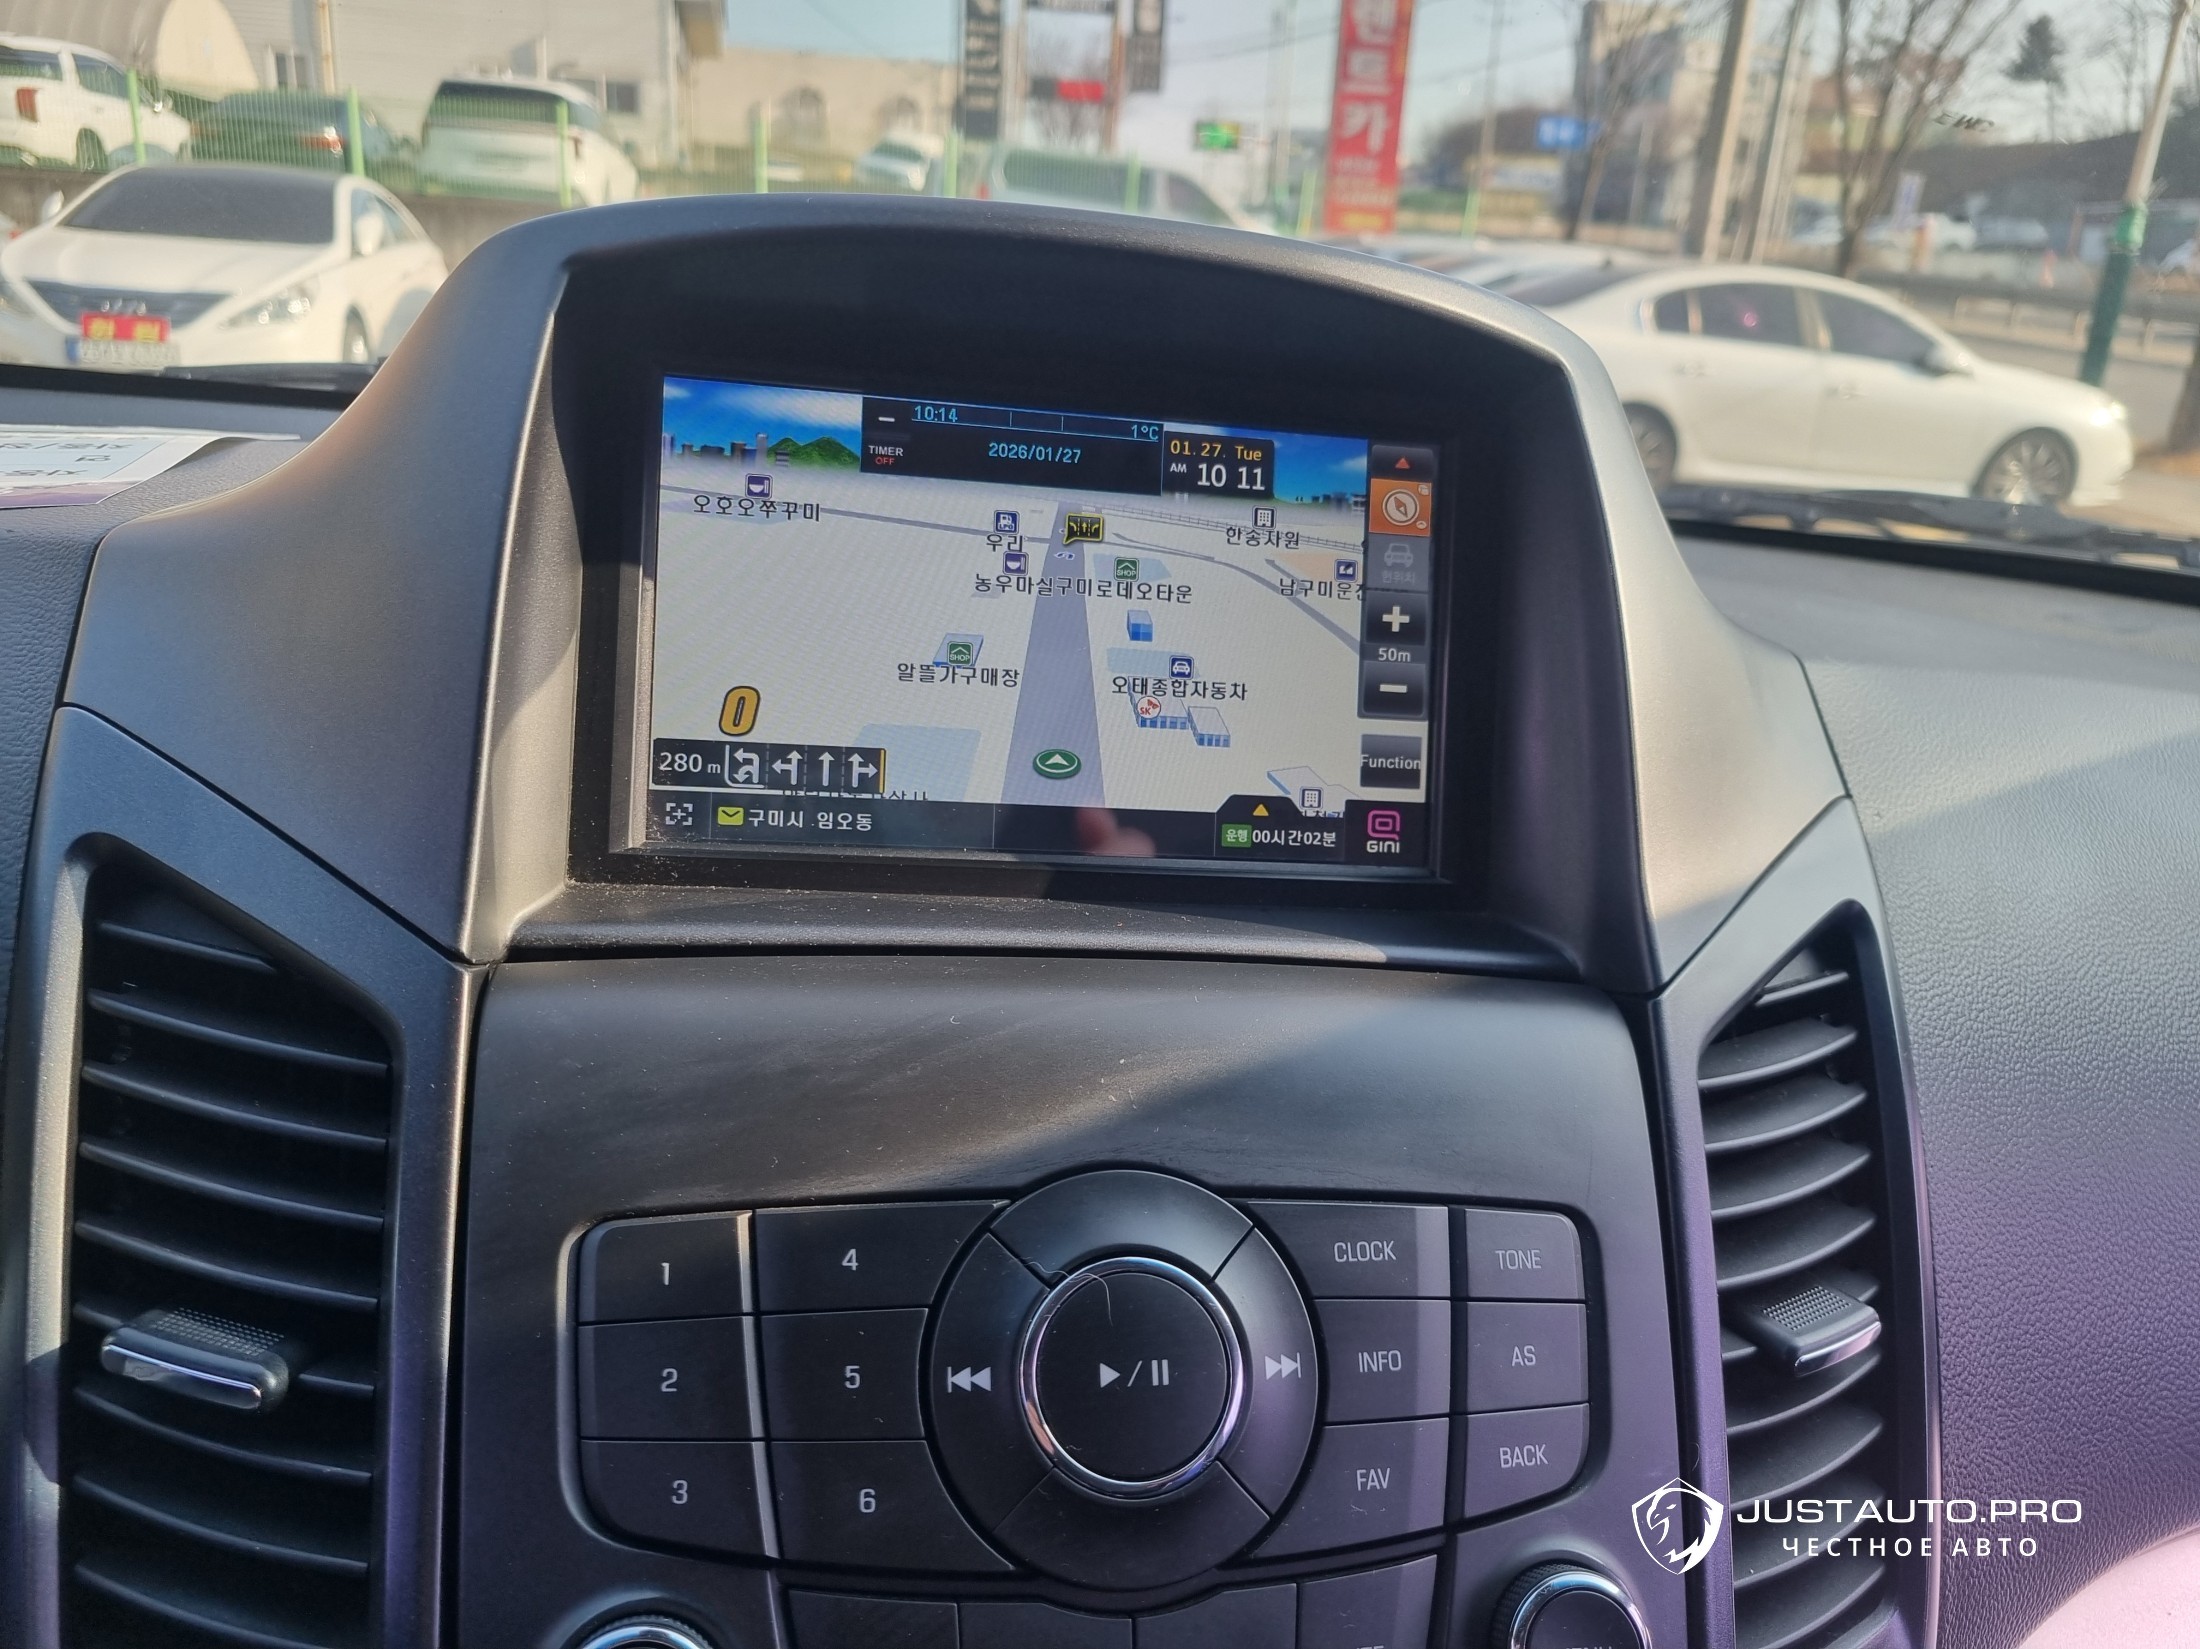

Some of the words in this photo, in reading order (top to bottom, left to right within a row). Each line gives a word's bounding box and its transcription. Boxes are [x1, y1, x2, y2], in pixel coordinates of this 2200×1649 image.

[914, 405, 958, 423] 10:14
[1131, 424, 1159, 440] 1°C
[868, 445, 904, 456] TIMER
[875, 457, 896, 466] OFF
[989, 442, 1081, 464] 2026/01/27
[1235, 445, 1262, 461] Tue
[1170, 462, 1187, 473] AM
[693, 494, 821, 522] 오호오쭈꾸미
[986, 533, 1024, 553] 우리
[1226, 526, 1300, 550] 한송자원
[1116, 569, 1137, 577] SHOP
[949, 653, 971, 662] SHOP
[1378, 648, 1411, 662] 50m
[897, 662, 1020, 688] 알뜰가구매장
[1111, 675, 1248, 701] 오태종합자동차
[718, 685, 761, 736] 0
[659, 752, 703, 773] 280
[1360, 754, 1421, 771] Function
[748, 809, 804, 828] 구미시
[817, 812, 873, 831] 임오동
[1366, 840, 1400, 853] GINI
[841, 1248, 859, 1271] 4
[1334, 1241, 1396, 1263] CLOCK
[1495, 1249, 1542, 1270] TONE
[661, 1262, 671, 1286] 1
[1358, 1349, 1402, 1373] INFO
[1511, 1345, 1537, 1367] AS
[660, 1367, 678, 1392] 2
[844, 1365, 861, 1390] 5
[1500, 1444, 1549, 1468] BACK
[1356, 1467, 1391, 1491] FAV
[672, 1479, 689, 1505] 3
[859, 1488, 877, 1514] 6
